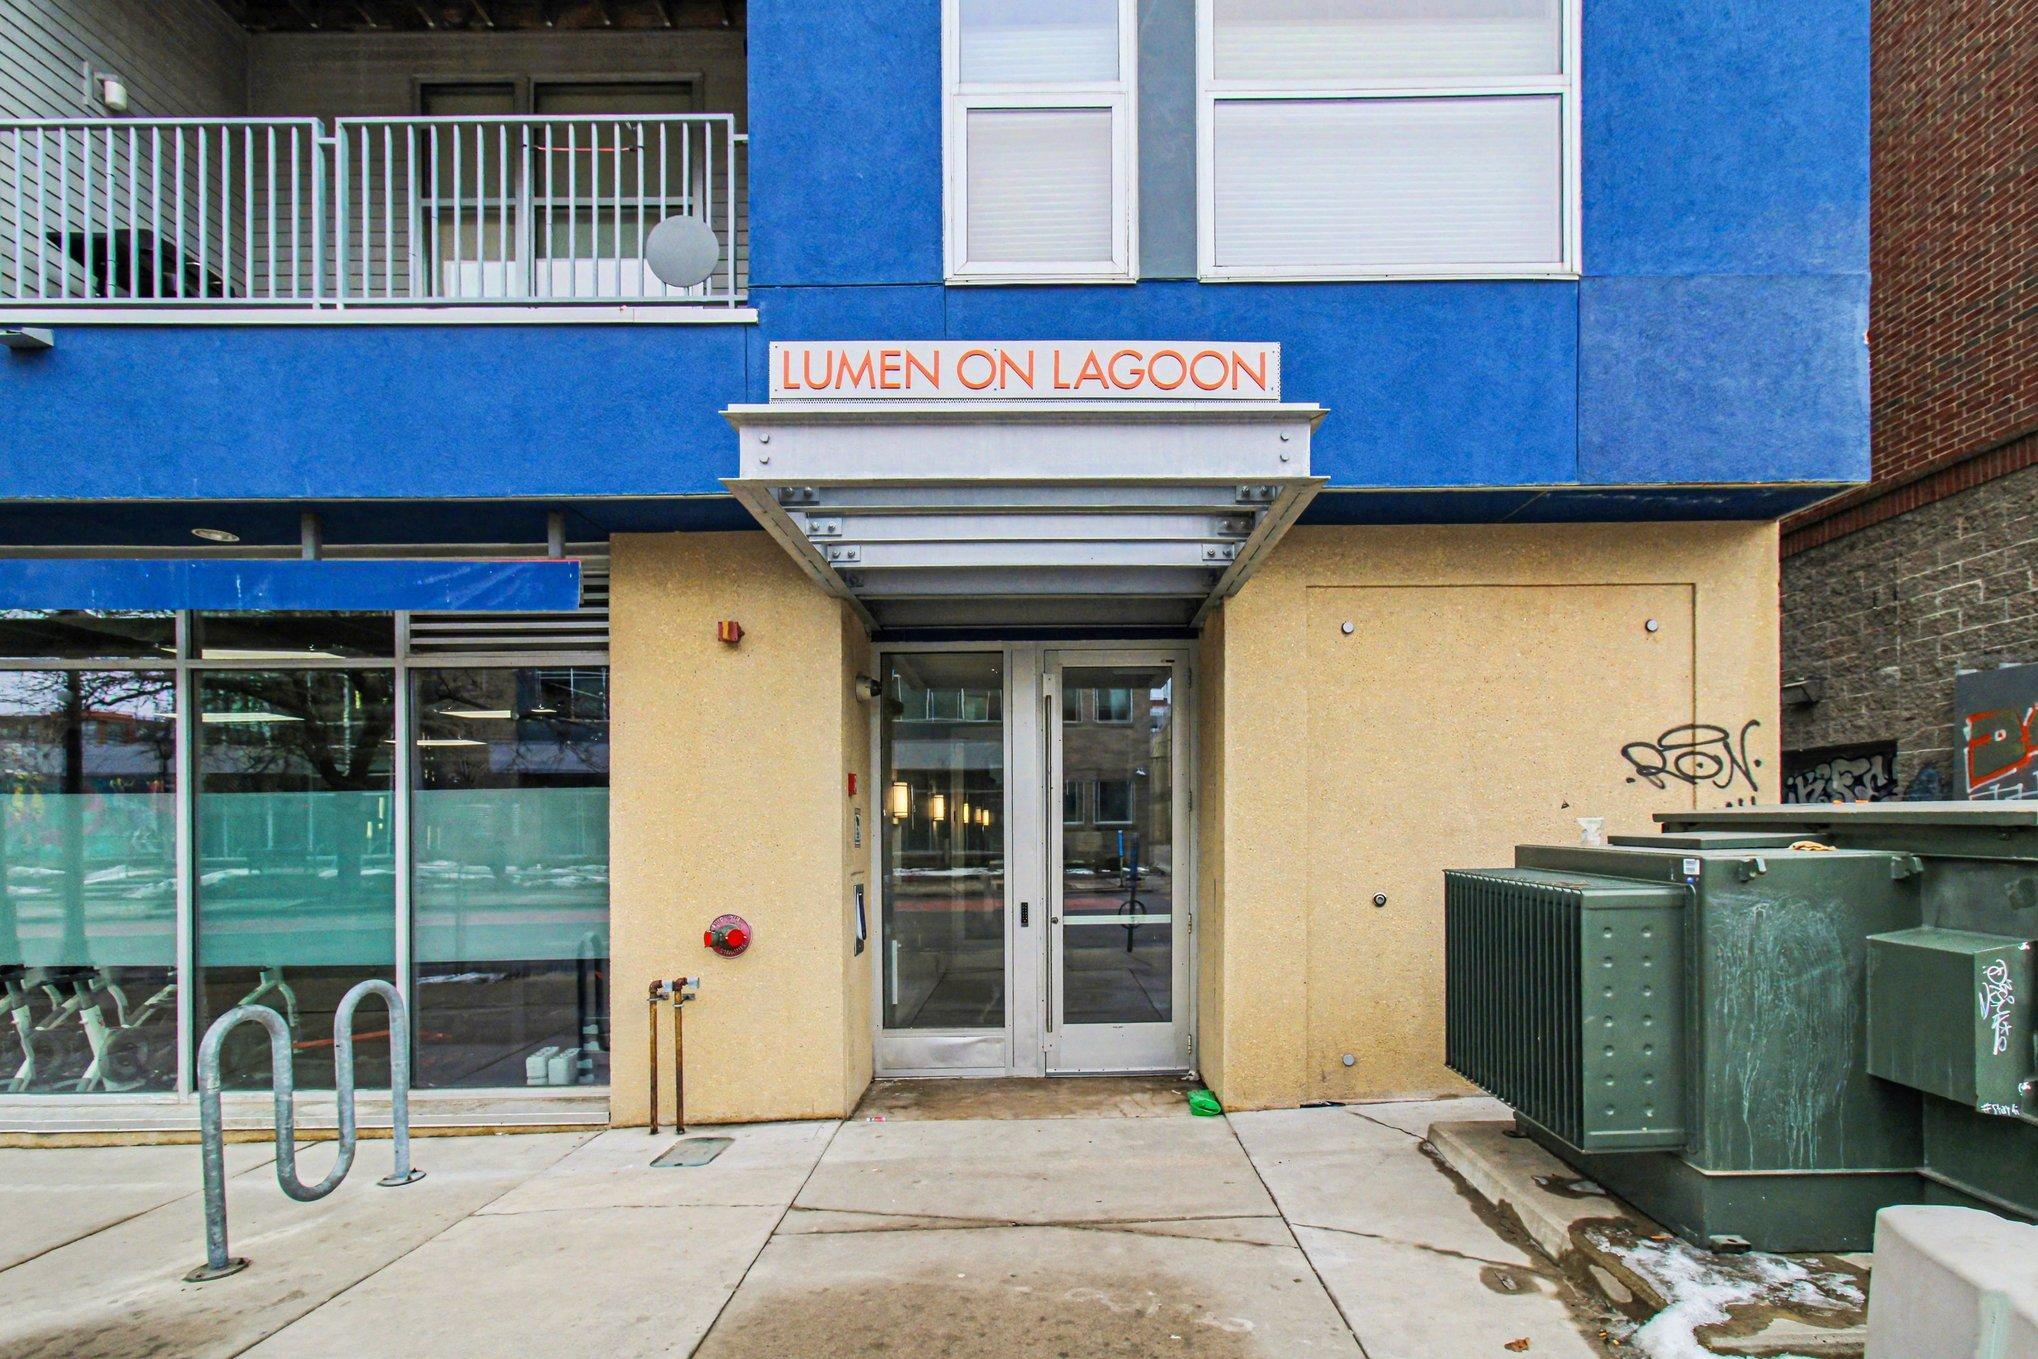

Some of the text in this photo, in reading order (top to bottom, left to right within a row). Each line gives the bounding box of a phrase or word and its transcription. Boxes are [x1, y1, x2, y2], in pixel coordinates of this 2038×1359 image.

[782, 348, 1267, 391] LUMEN ON LAGOON
